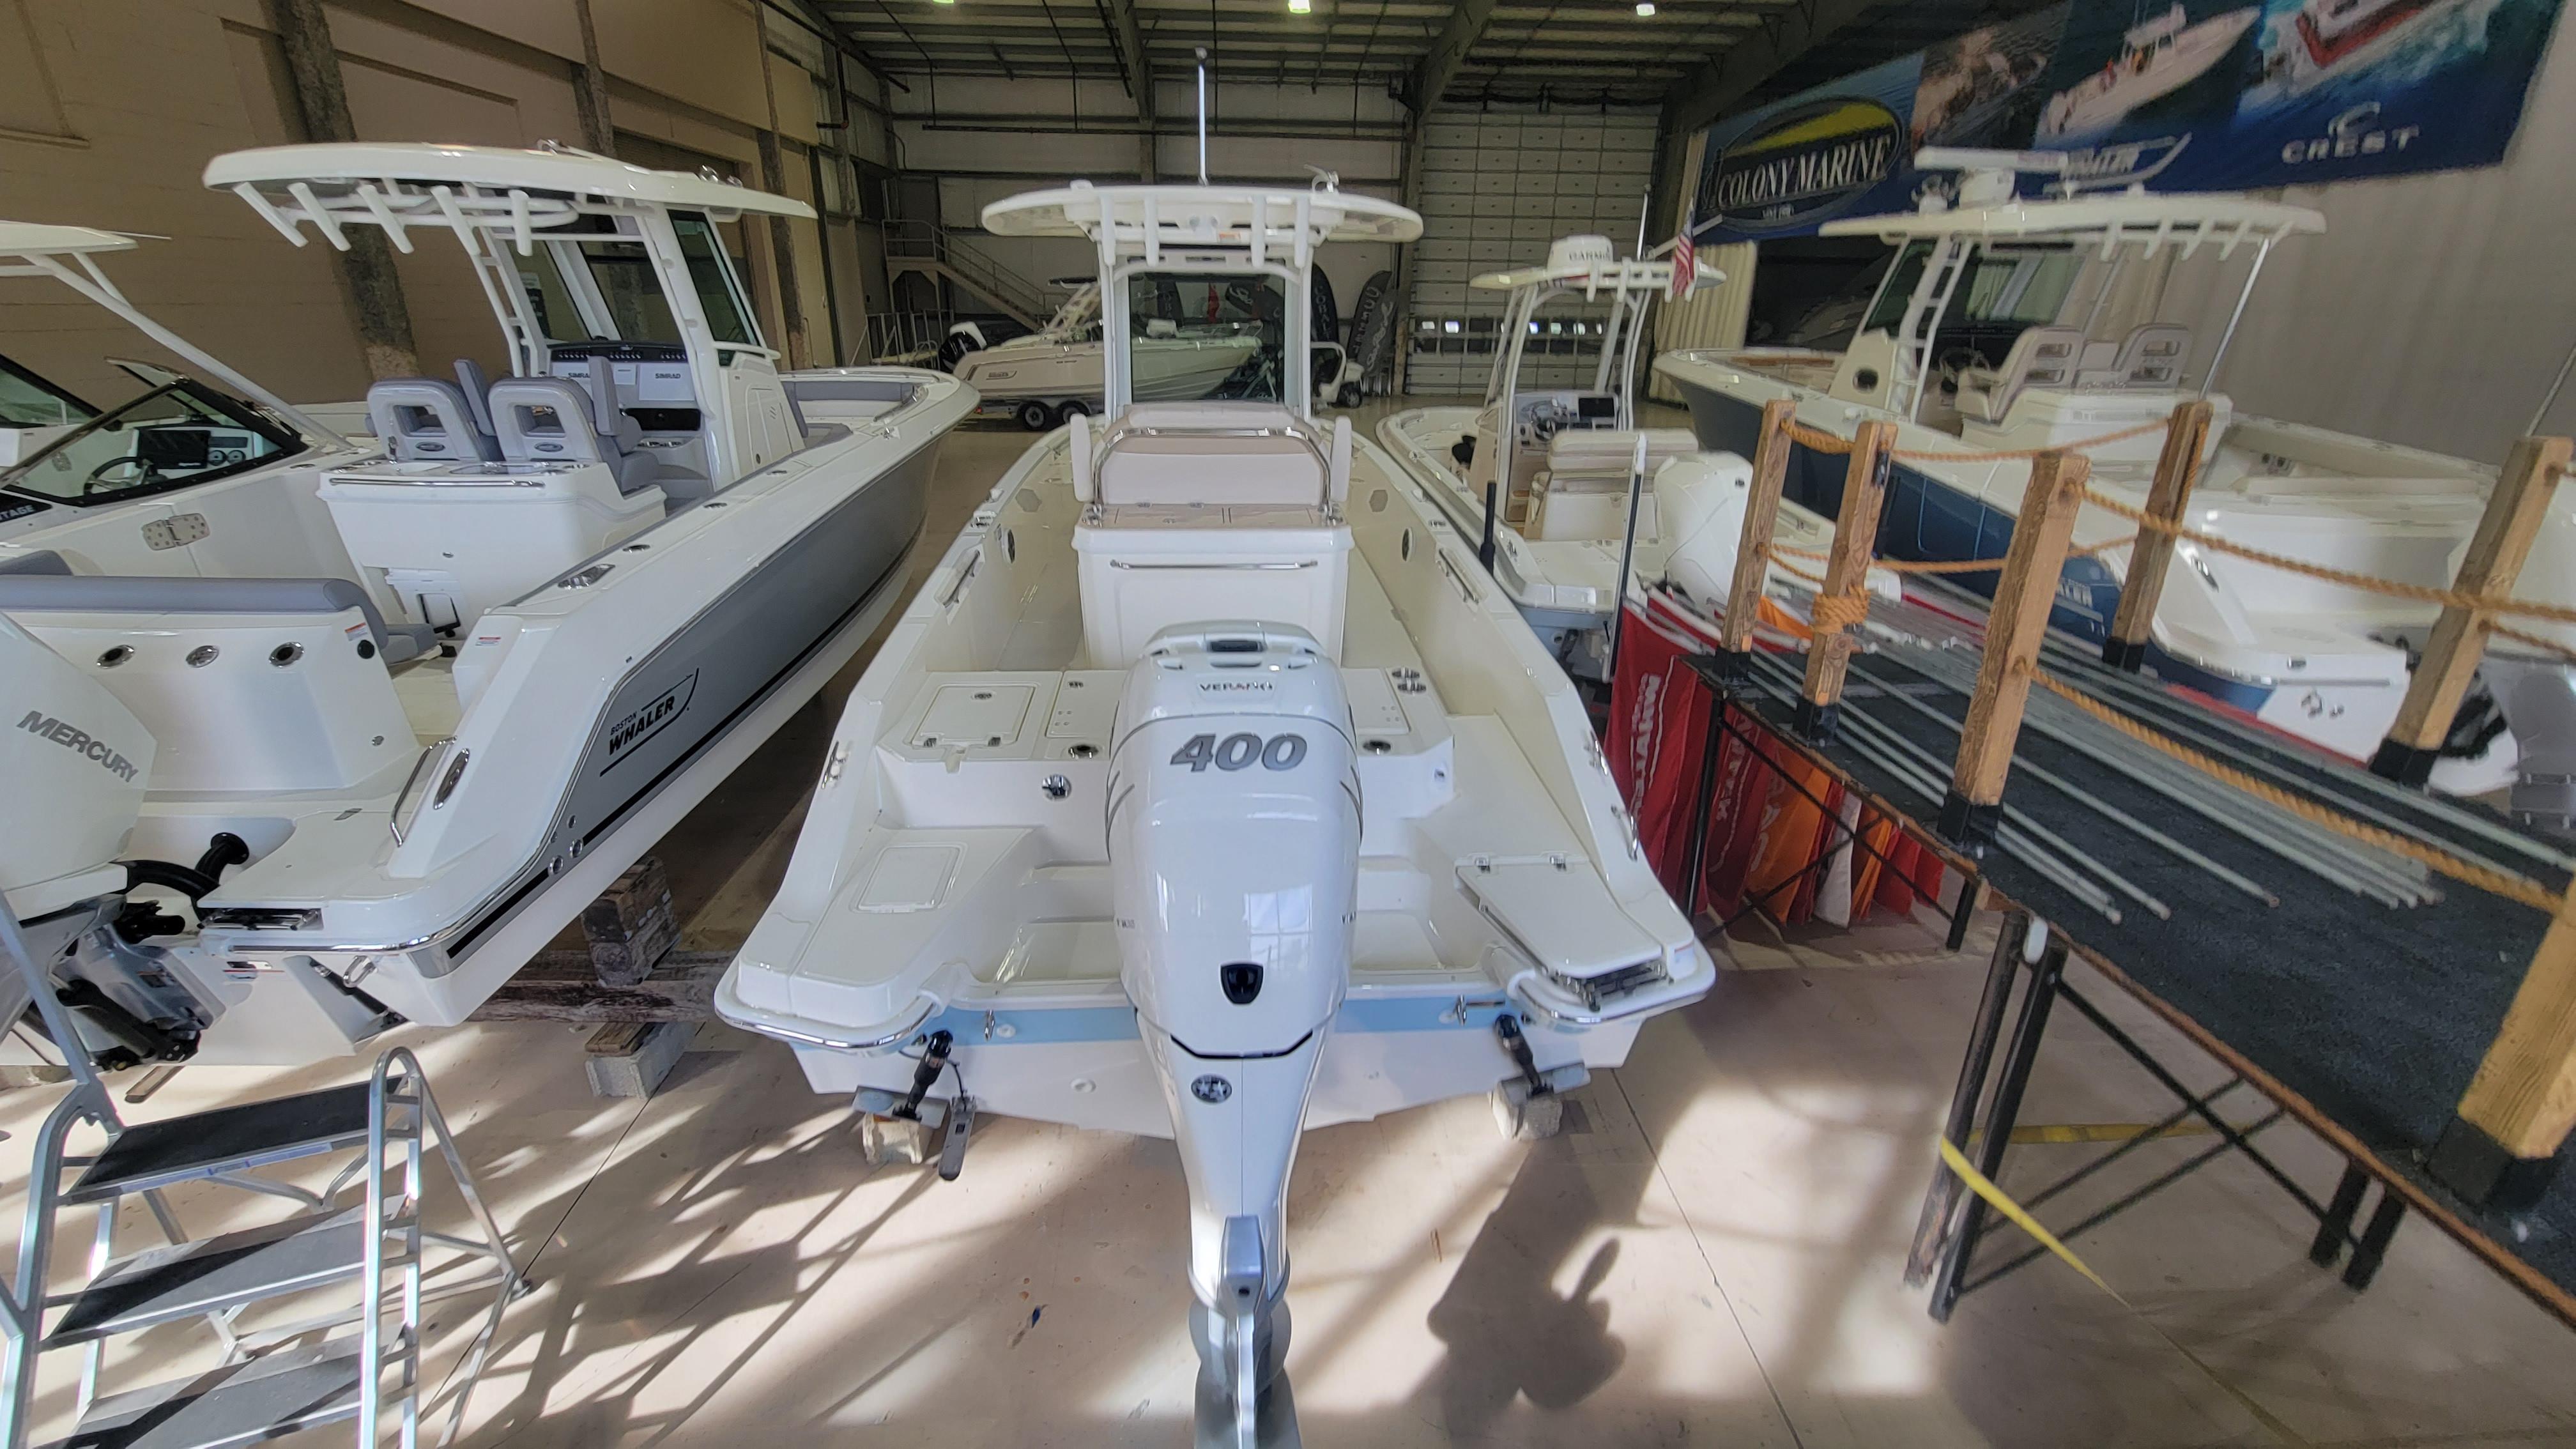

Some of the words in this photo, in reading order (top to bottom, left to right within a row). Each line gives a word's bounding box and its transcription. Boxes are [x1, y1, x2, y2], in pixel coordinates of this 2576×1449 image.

[1718, 157, 1794, 207] COLONY
[1795, 134, 1891, 195] MARINE
[16, 710, 139, 783] MERCURY
[609, 695, 675, 750] WHALER
[610, 710, 638, 735] BOSTON
[1170, 733, 1308, 772] 400
